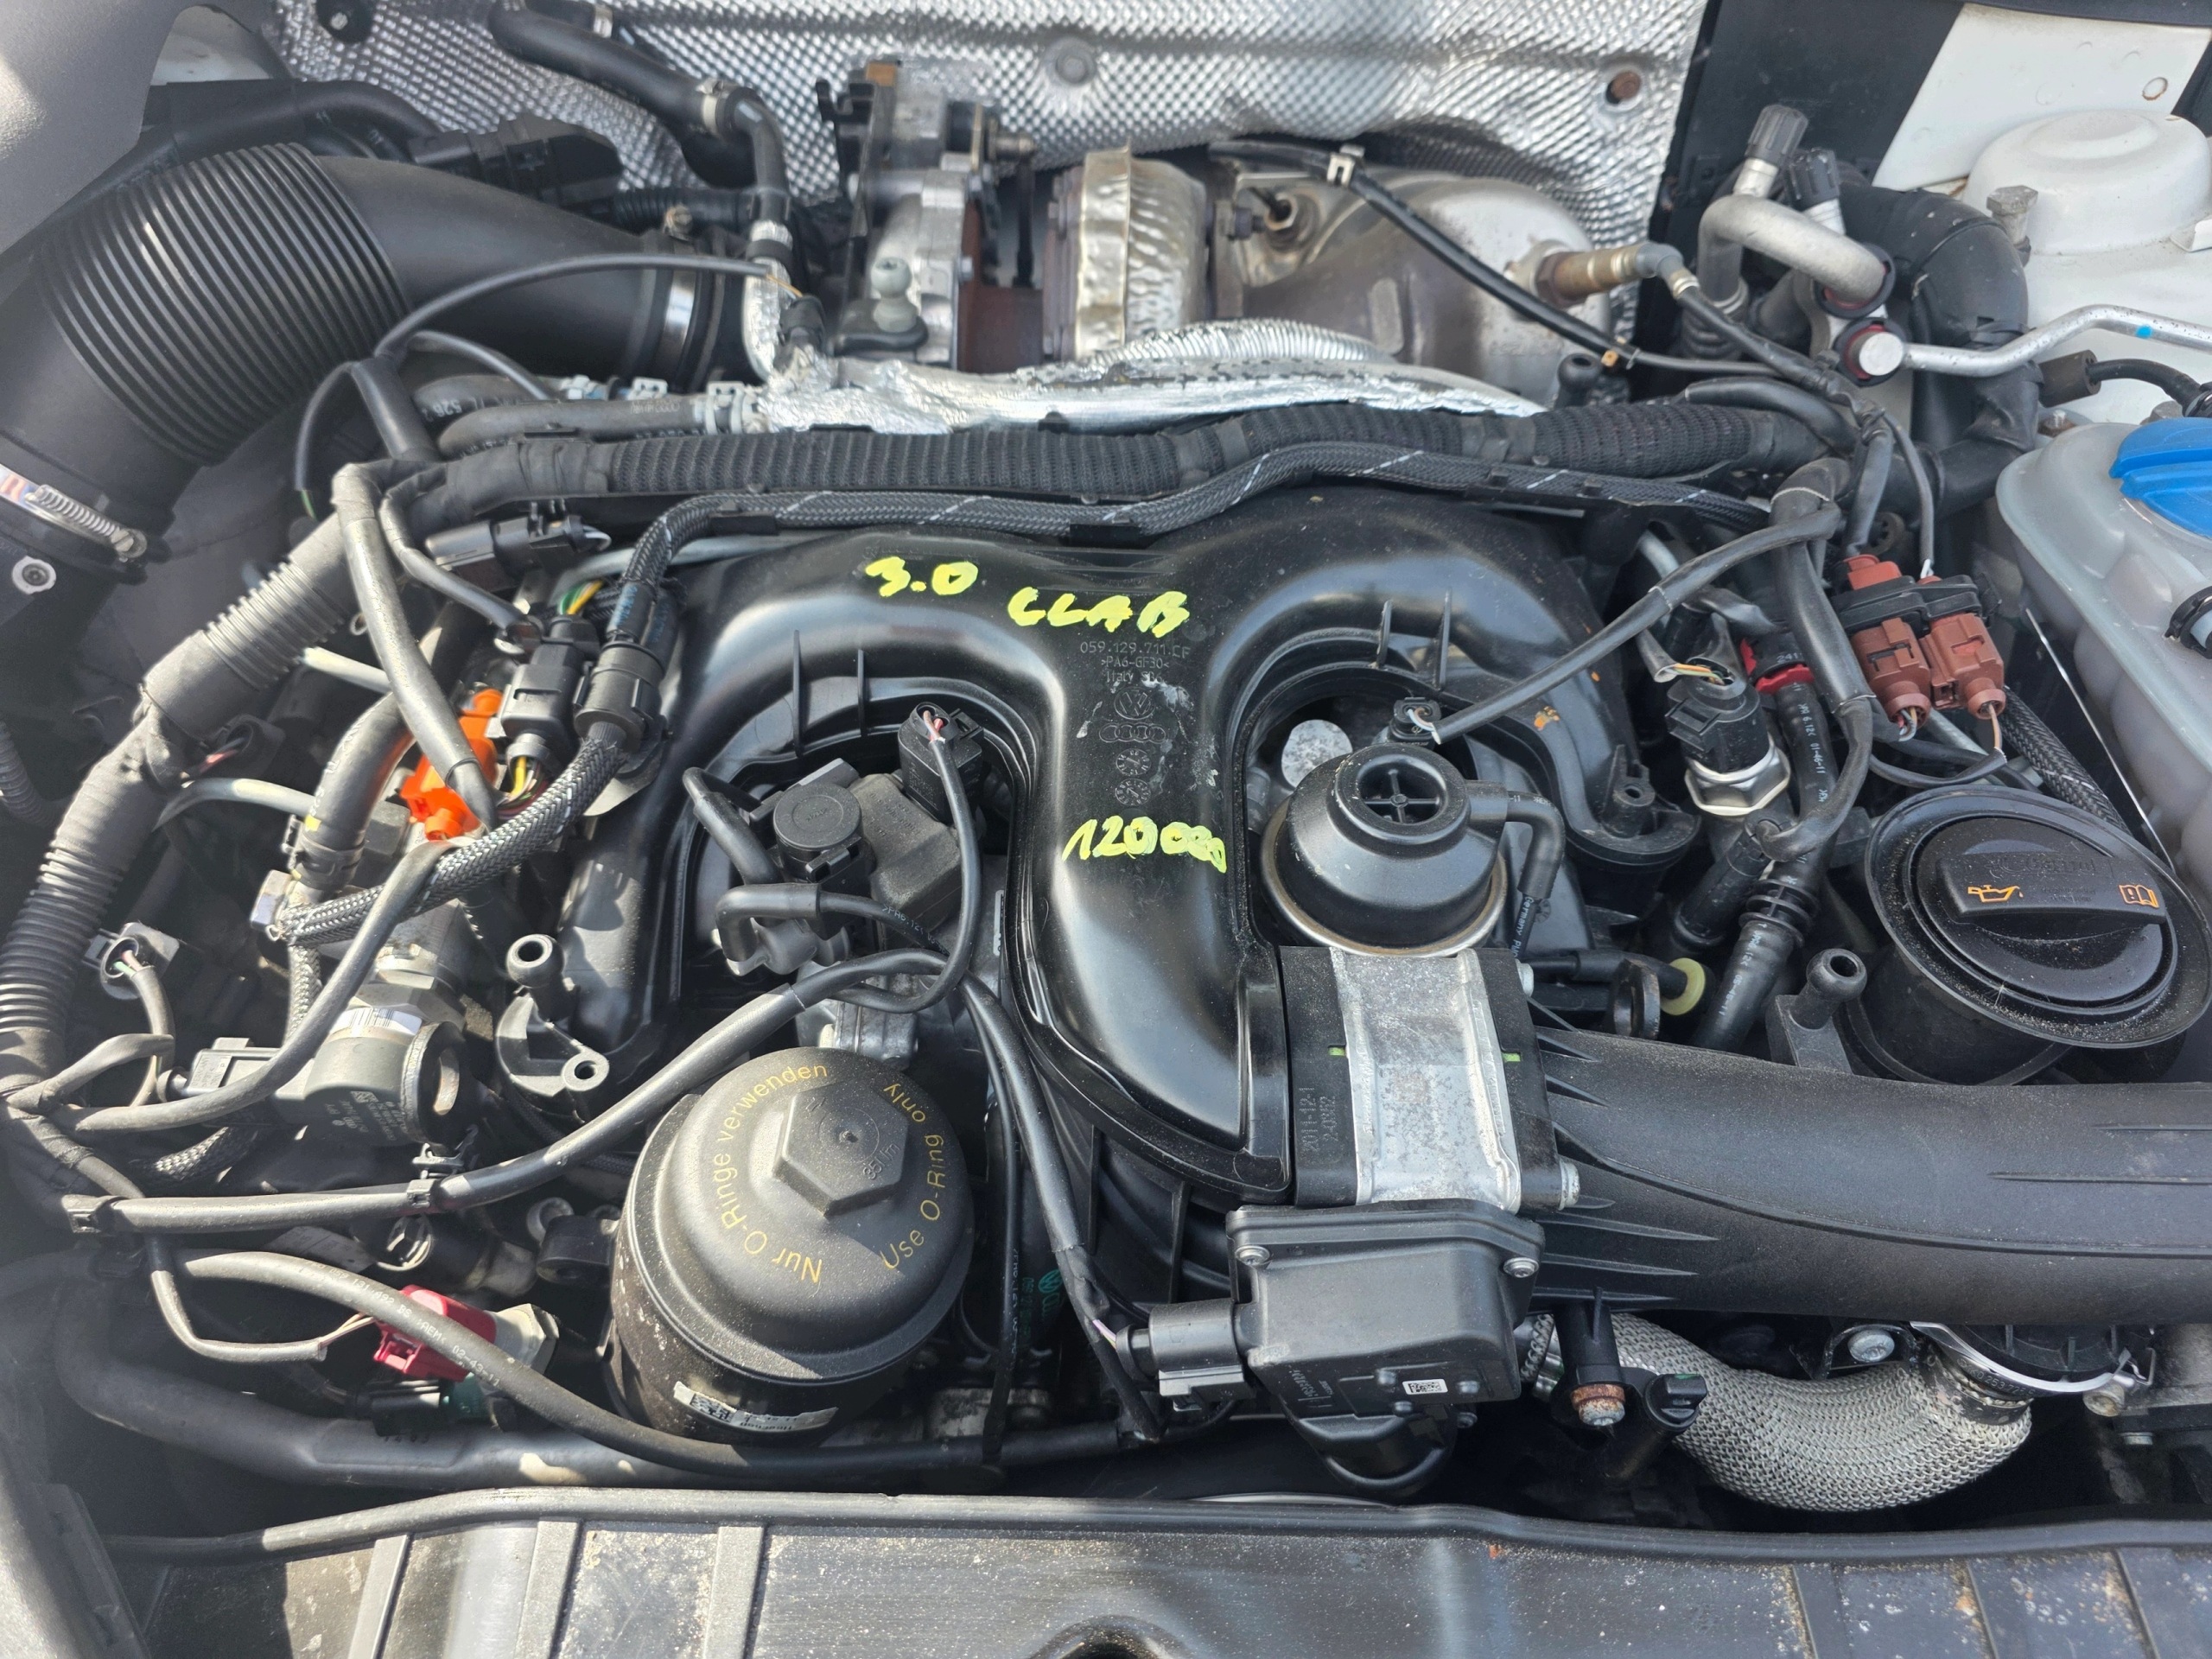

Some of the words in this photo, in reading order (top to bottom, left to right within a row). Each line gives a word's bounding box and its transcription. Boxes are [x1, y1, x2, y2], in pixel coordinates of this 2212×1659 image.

[865, 556, 979, 597] 3.0
[1079, 641, 1191, 658] 059.129.711.CF
[1106, 671, 1135, 683] Italy
[1516, 896, 1535, 936] Germany
[717, 1064, 829, 1143] verwenden
[882, 1082, 927, 1123] only
[919, 1133, 946, 1222] O-Ring
[713, 1152, 768, 1255] O-Ringe
[771, 1248, 823, 1284] Nur
[879, 1229, 925, 1270] Use
